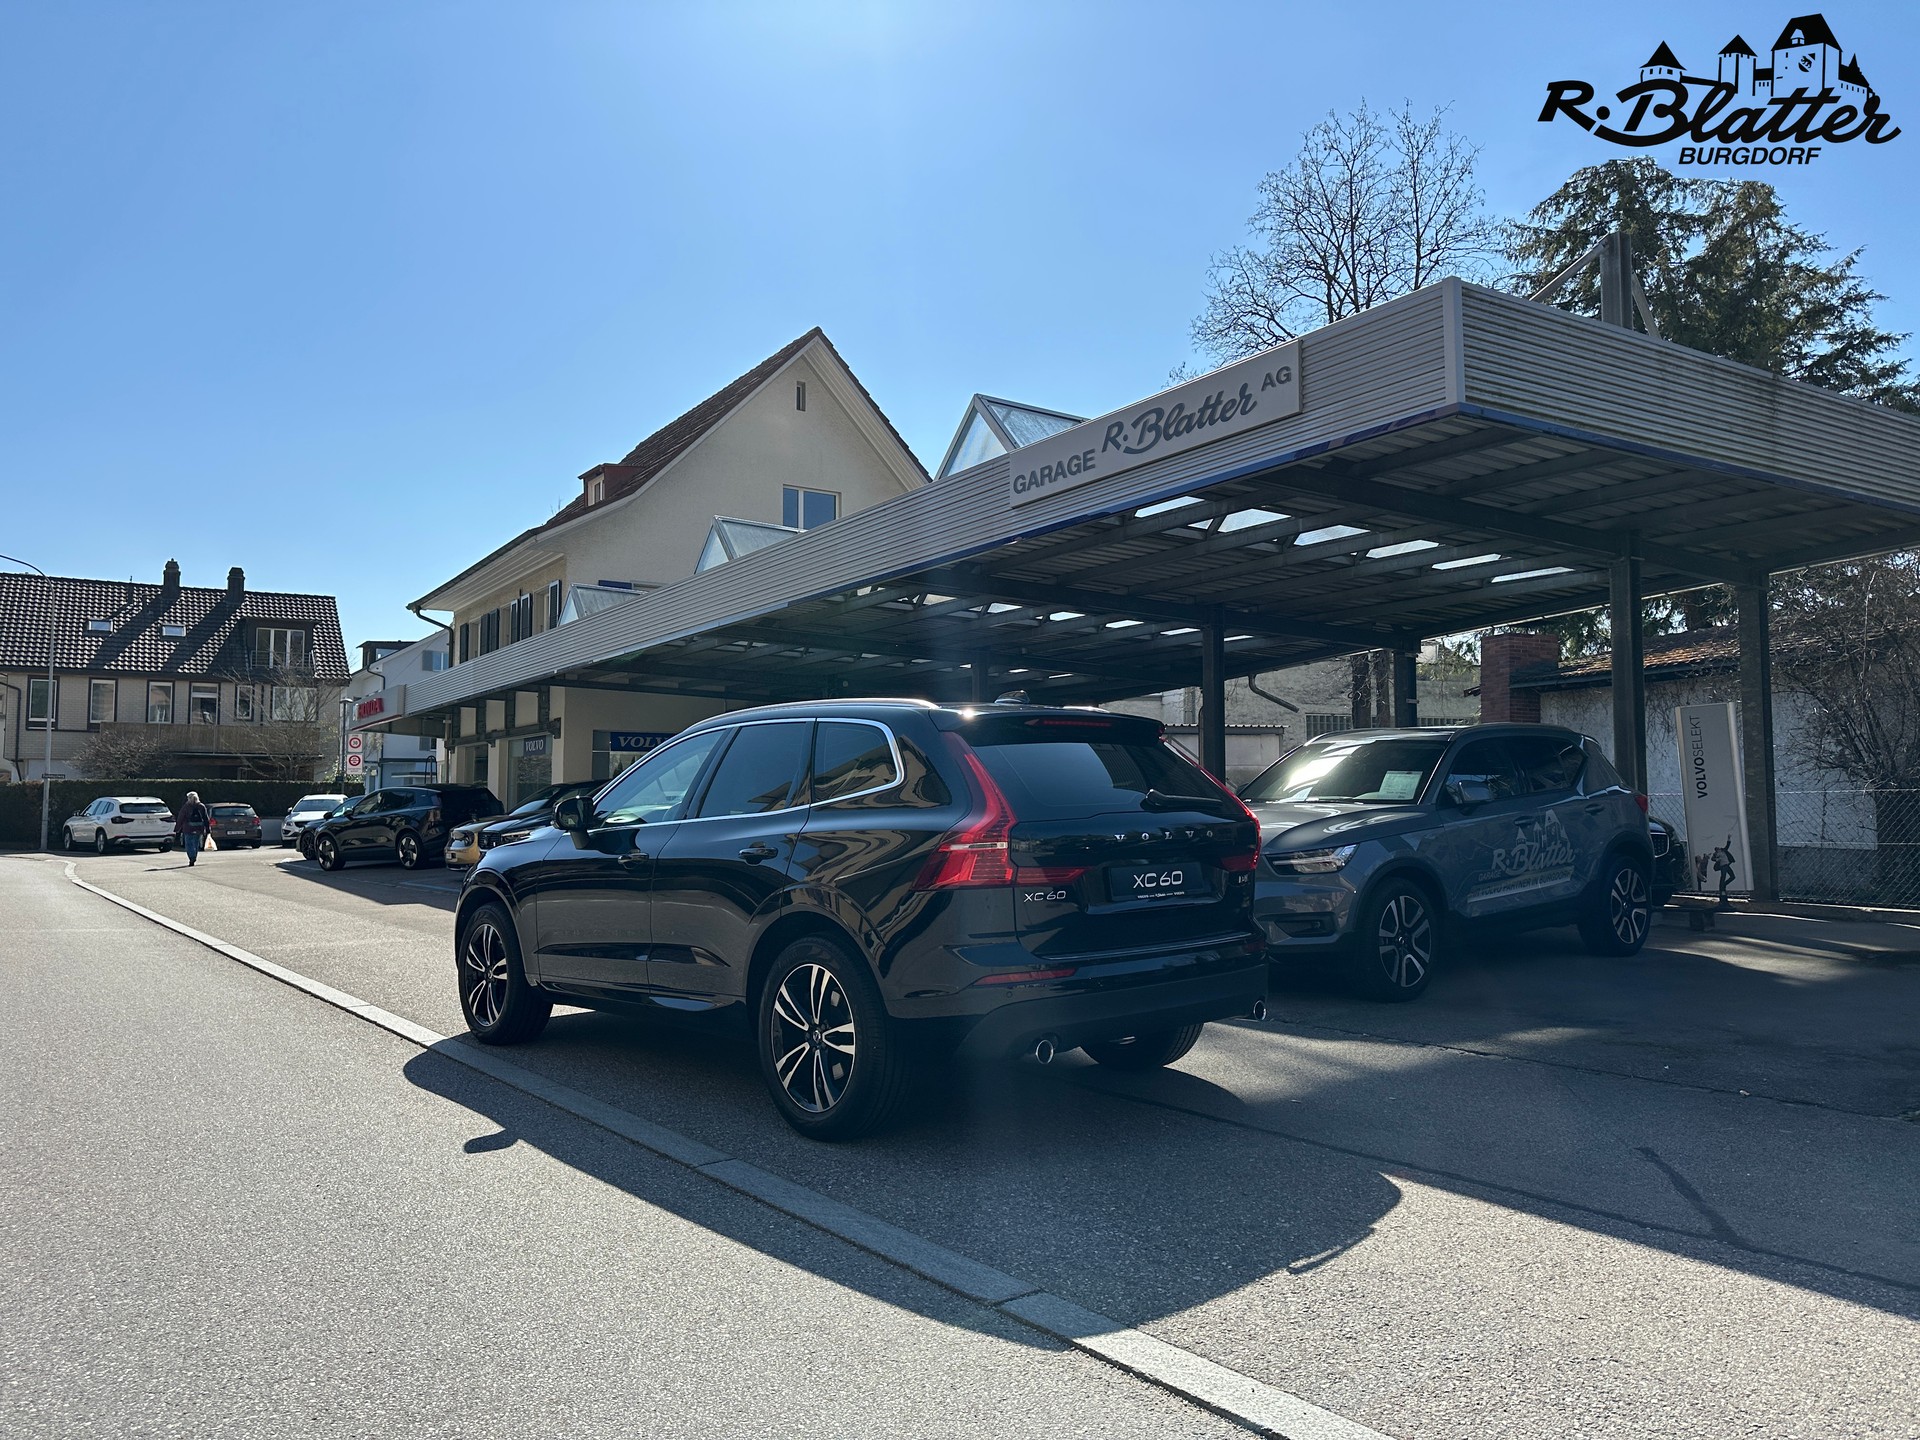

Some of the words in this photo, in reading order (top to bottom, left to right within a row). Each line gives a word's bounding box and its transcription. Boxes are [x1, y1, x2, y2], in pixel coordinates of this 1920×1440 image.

[1013, 448, 1096, 495] GARAGE
[1261, 366, 1292, 392] AG
[358, 697, 384, 719] HONDA
[525, 738, 544, 752] VOLVO
[1114, 830, 1214, 842] VOLVO
